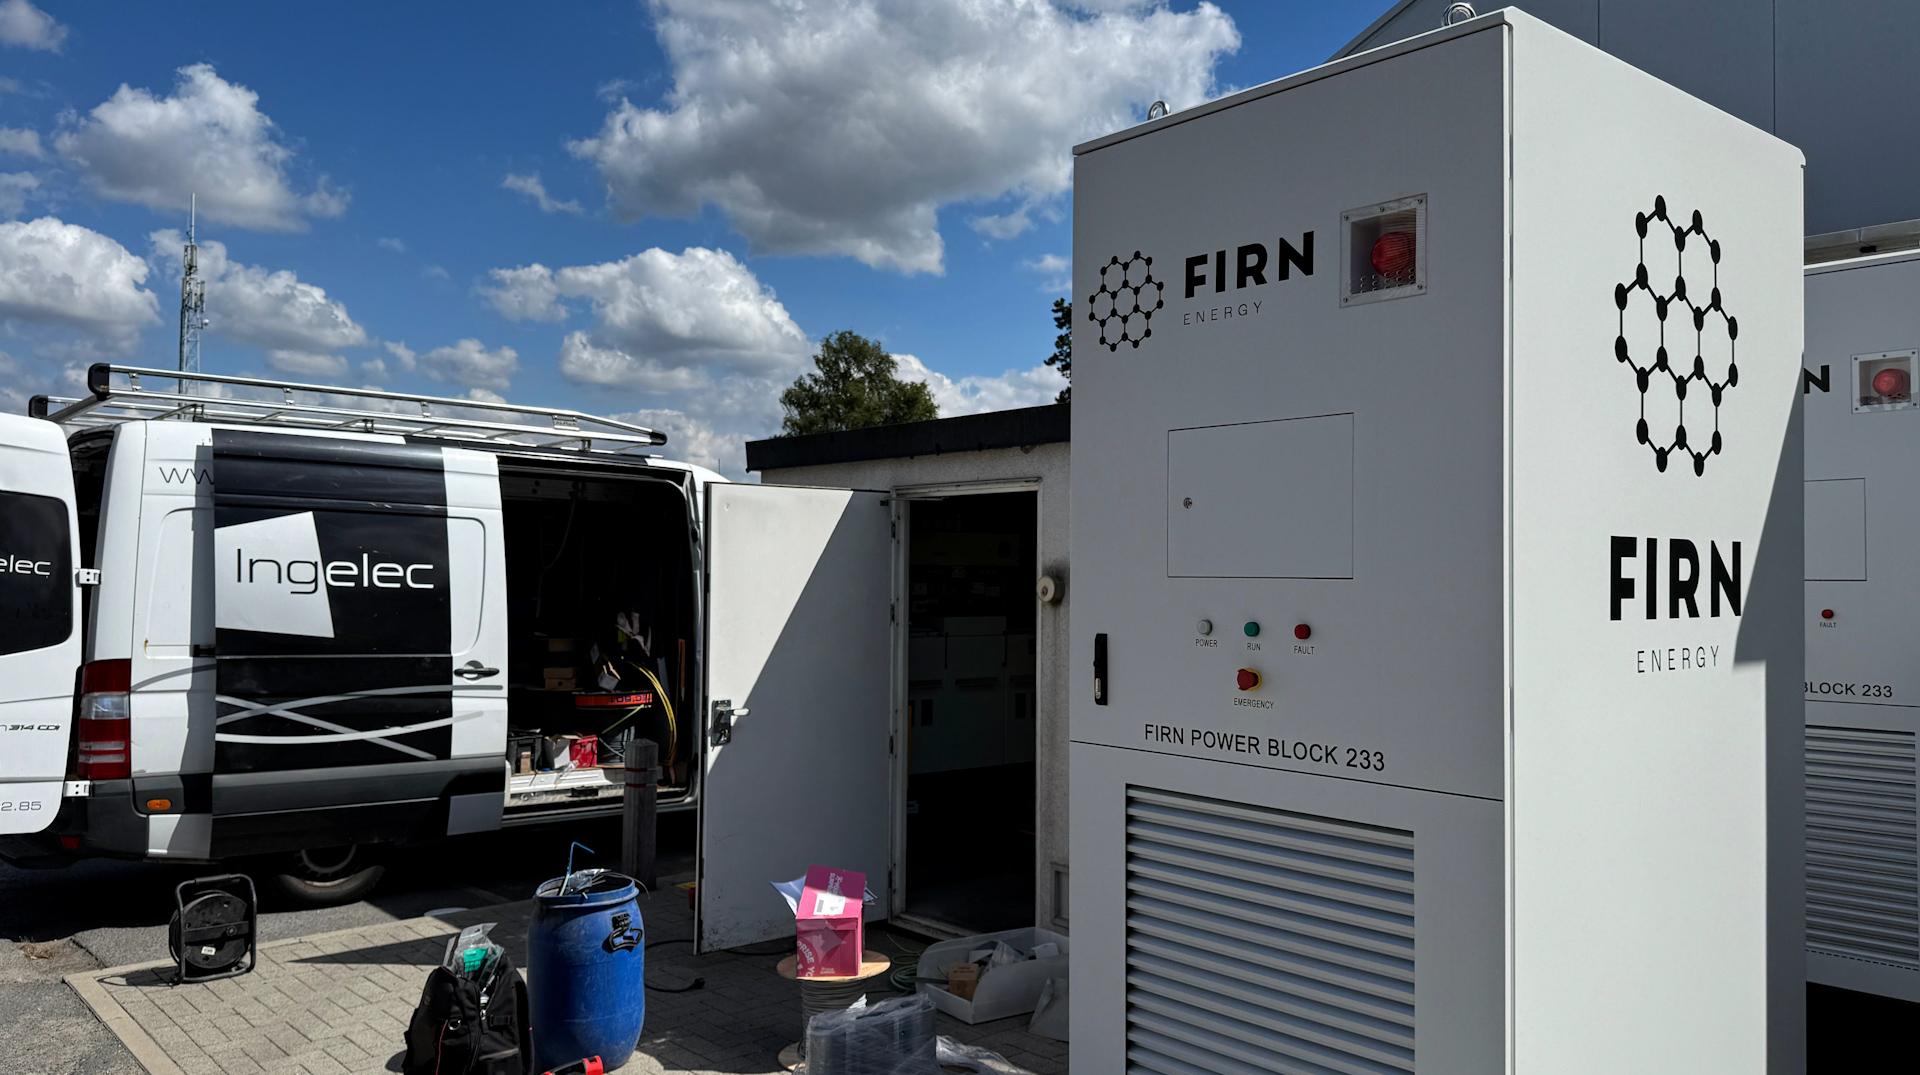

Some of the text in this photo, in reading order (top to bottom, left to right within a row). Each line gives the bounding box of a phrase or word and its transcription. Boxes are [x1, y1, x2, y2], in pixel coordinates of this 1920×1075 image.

[1185, 231, 1314, 298] FIRN
[1183, 301, 1262, 325] ENERGY
[237, 548, 434, 594] Ingelec
[1610, 535, 1741, 621] FIRN
[1195, 638, 1218, 648] POWER
[1247, 642, 1261, 651] RUN
[1294, 646, 1315, 655] FAULT
[1637, 645, 1719, 673] ENERGY
[1861, 684, 1893, 698] 233
[1234, 698, 1274, 710] EMERGENCY
[1145, 723, 1385, 772] FIRN POWER BLOCK 233
